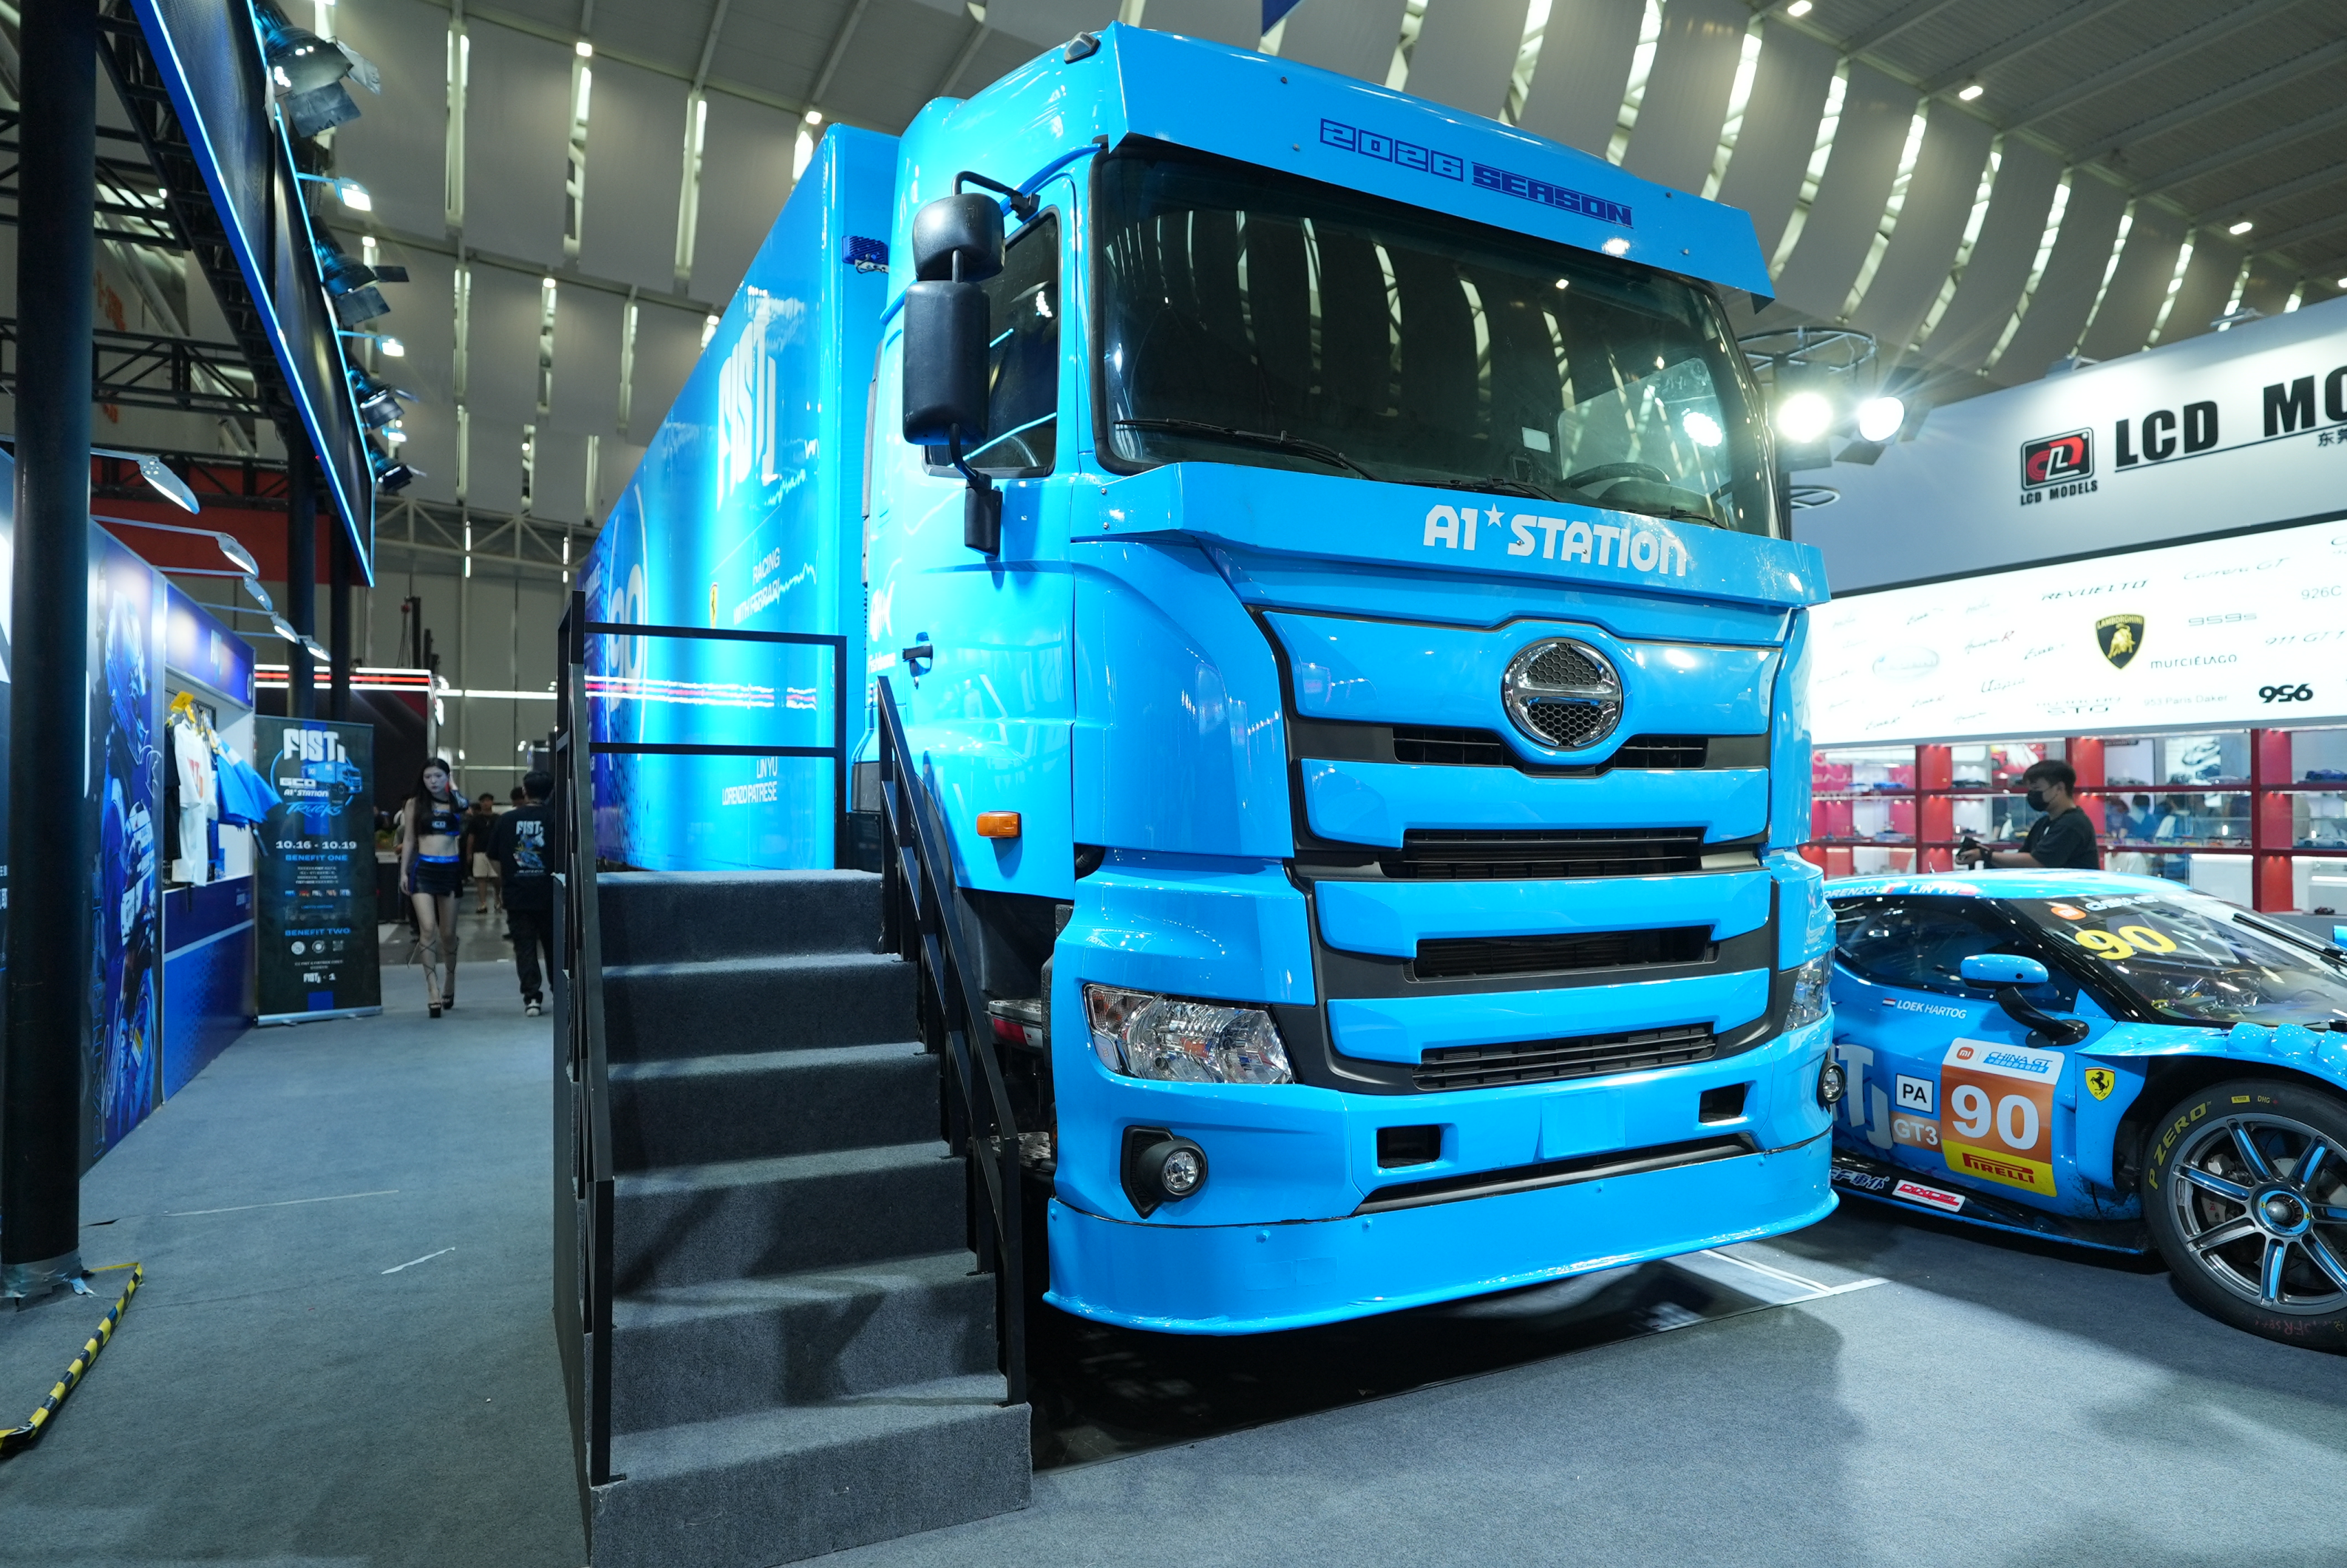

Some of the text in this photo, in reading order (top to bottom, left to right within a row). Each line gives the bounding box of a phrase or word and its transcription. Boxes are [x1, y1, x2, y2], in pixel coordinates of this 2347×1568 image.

[1319, 118, 1634, 229] 2026 SEASON
[2116, 400, 2218, 467] LCD
[2020, 479, 2098, 506] LCD MODELS
[1507, 513, 1690, 577] STATION
[753, 547, 781, 586] RACING
[2256, 557, 2291, 570] GT
[2301, 586, 2342, 600] 926C
[2096, 615, 2144, 628] LAMBORGHINI
[2258, 683, 2314, 704] 956
[756, 756, 778, 778] LIN YU
[722, 781, 778, 805] LORENZO PATRESE
[276, 841, 311, 849] 10.16
[322, 841, 357, 849] 10.19
[1909, 884, 1932, 894] LIN
[2075, 926, 2178, 960] 90
[1897, 999, 1967, 1019] LOEK HARTOG
[1988, 1051, 2028, 1065] CHINA
[2032, 1058, 2054, 1067] GT
[1903, 1083, 1927, 1104] PA
[2257, 1095, 2271, 1104] DHG
[1951, 1084, 2039, 1150] 90
[1893, 1119, 1938, 1145] GT3
[2148, 1102, 2207, 1190] P ZERO
[1962, 1153, 2035, 1184] PIRELLI
[1898, 1184, 1960, 1206] DIXCEL
